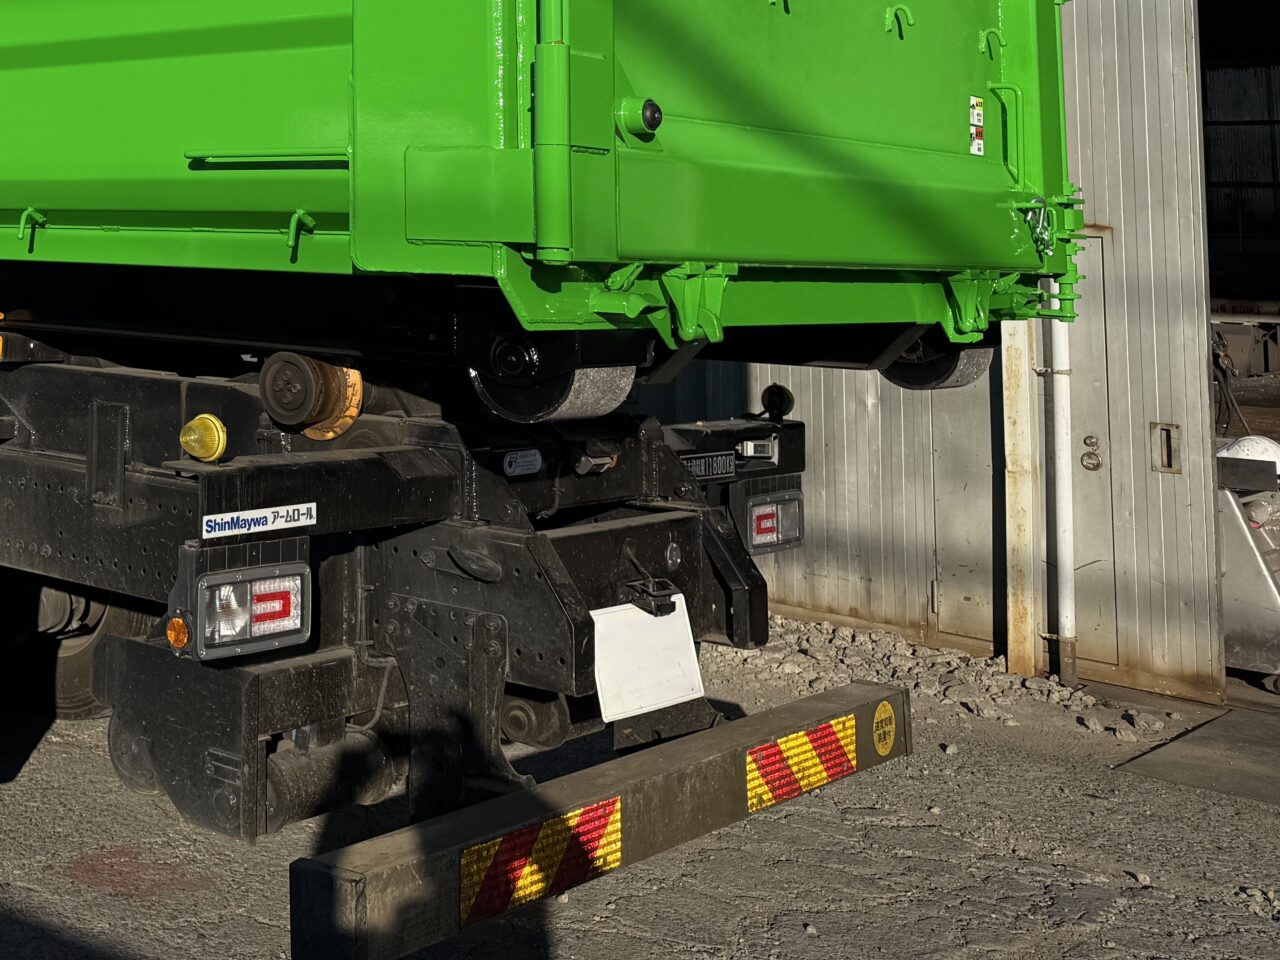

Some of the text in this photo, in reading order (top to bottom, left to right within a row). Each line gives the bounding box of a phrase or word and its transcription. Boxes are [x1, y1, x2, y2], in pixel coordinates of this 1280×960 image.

[205, 507, 313, 533] ShinMaywa アームロール
